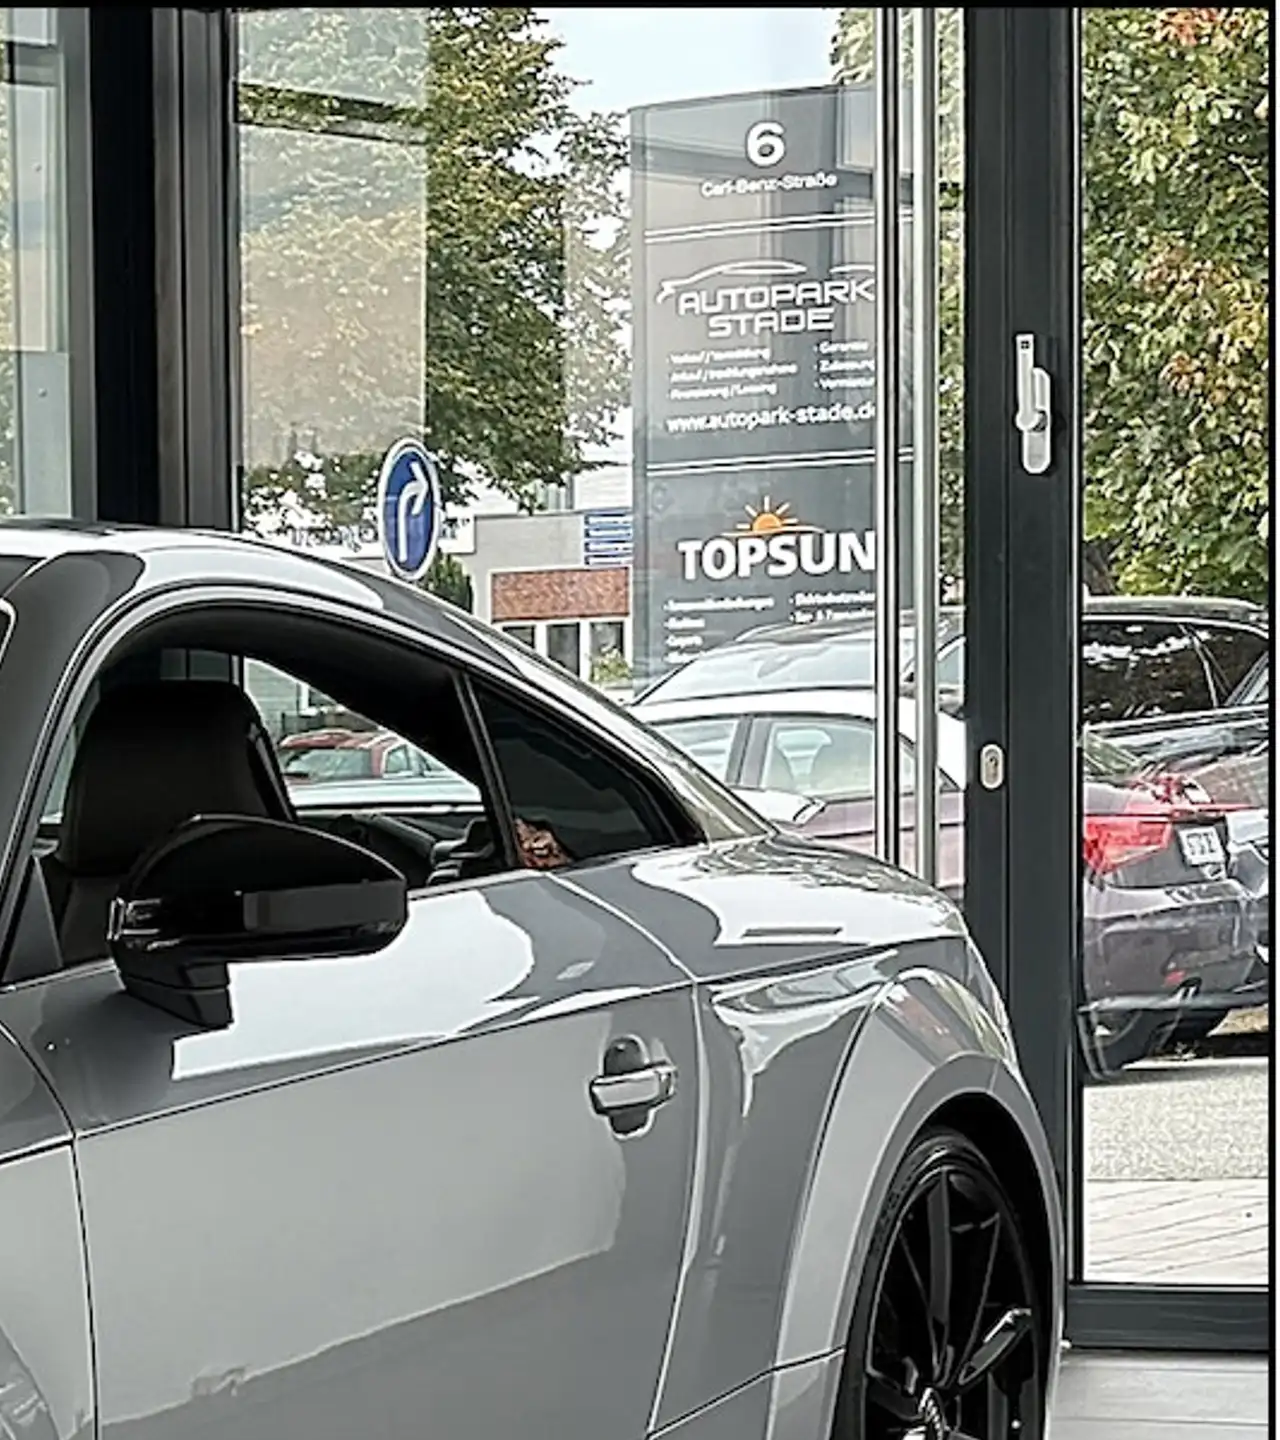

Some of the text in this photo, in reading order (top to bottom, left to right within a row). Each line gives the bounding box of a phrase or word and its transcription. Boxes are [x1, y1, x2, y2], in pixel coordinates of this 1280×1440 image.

[746, 120, 786, 167] 6
[677, 278, 875, 316] AUTOPARK
[707, 306, 835, 338] STADE
[666, 402, 875, 433] www.autopark-stade.d
[677, 530, 876, 581] TOPSUN
